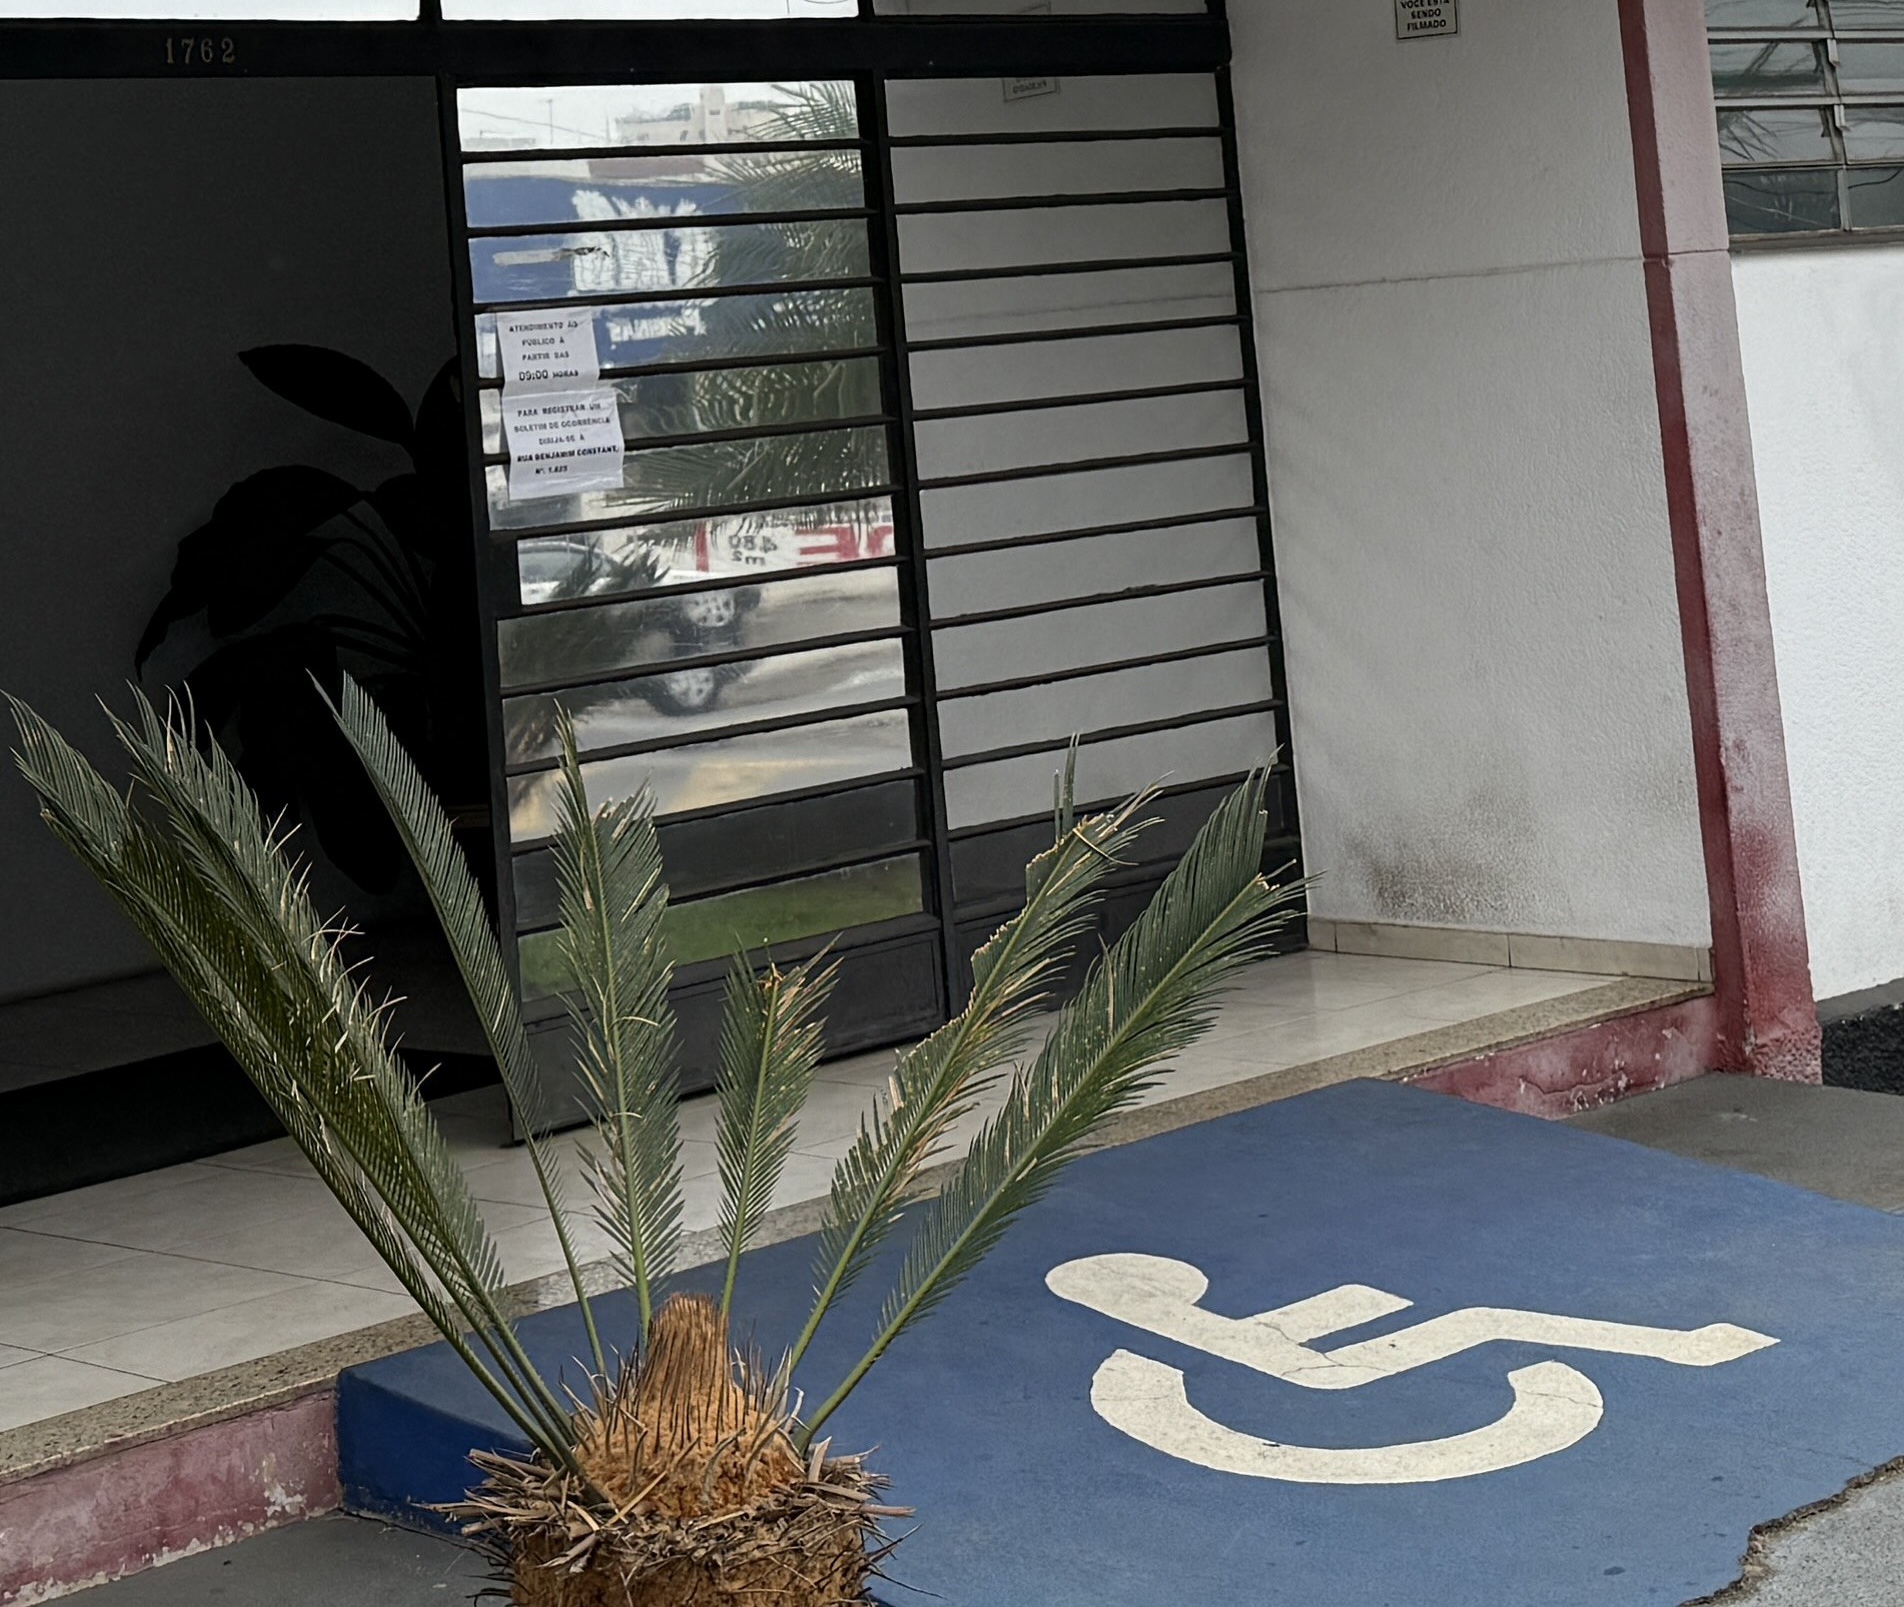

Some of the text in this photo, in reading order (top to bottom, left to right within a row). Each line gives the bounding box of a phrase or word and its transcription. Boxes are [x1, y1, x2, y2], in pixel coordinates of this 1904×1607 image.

[1411, 7, 1442, 20] SENDO
[1407, 19, 1447, 32] FILMADO
[165, 37, 236, 65] 1762
[517, 408, 539, 418] PARA
[542, 403, 586, 415] REGISTRAR
[517, 453, 534, 463] RUA
